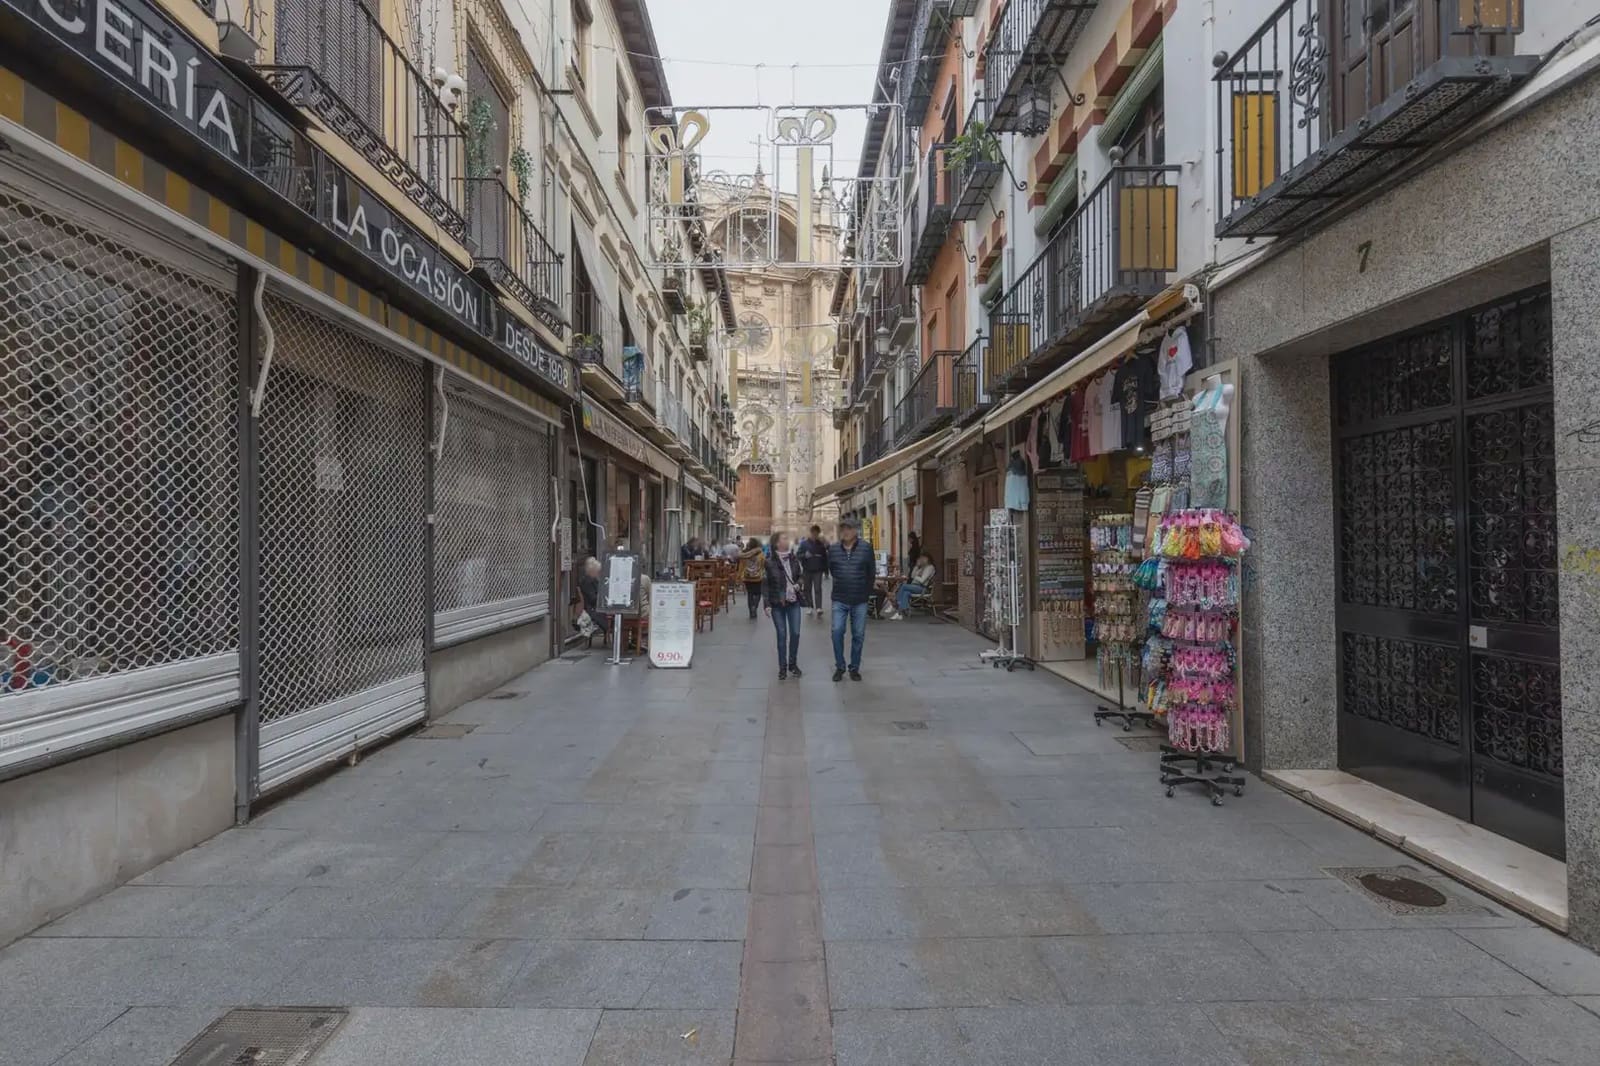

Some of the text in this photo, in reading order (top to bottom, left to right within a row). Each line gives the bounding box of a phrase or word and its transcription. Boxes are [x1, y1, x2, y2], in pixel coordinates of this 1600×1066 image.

[332, 184, 371, 249] LA
[380, 228, 477, 325] OCASIÓN
[506, 322, 544, 372] DESDE
[548, 357, 568, 389] 1908
[1358, 240, 1372, 273] 7
